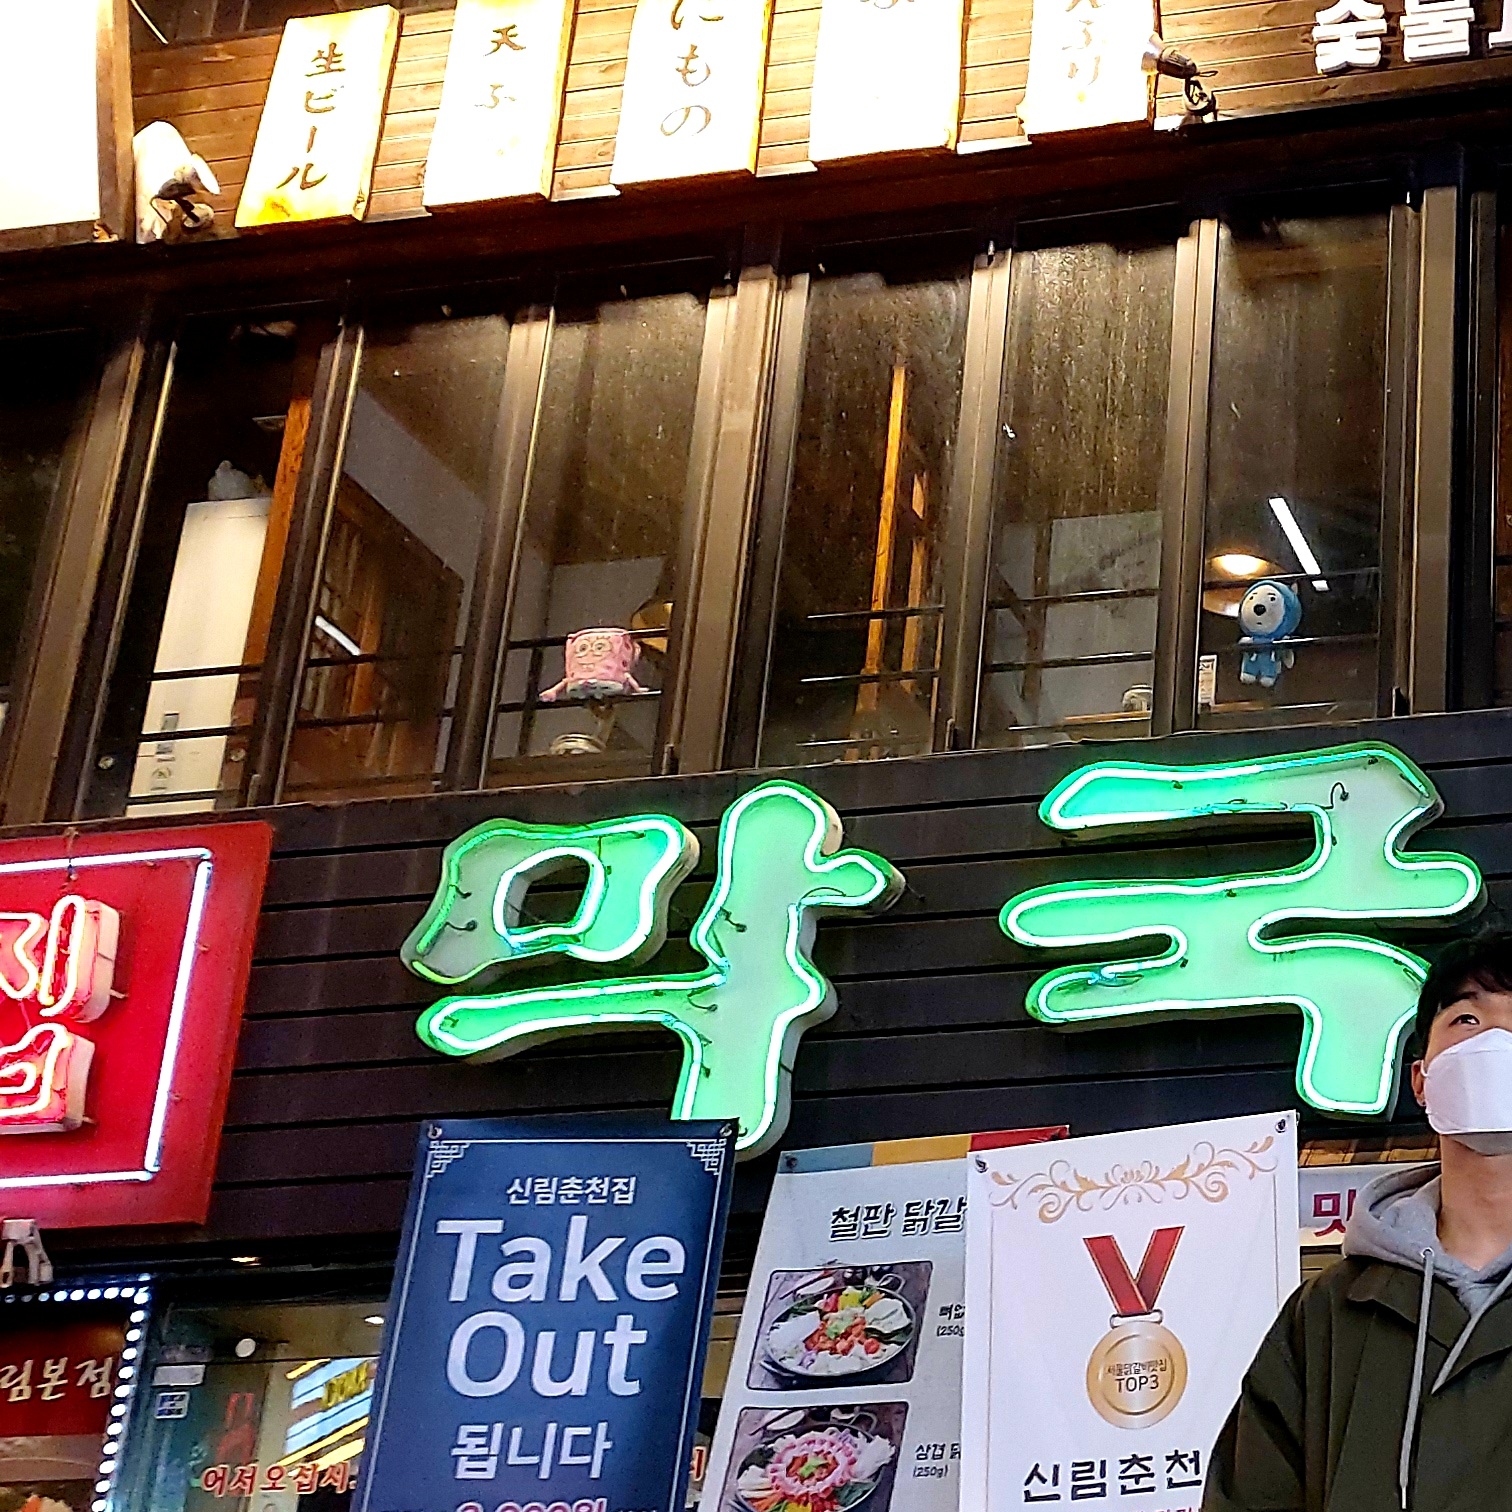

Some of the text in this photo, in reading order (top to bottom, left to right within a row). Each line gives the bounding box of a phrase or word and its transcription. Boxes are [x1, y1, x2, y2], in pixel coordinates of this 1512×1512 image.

[269, 42, 346, 190] 生ビール
[507, 1176, 637, 1206] 신림춘천집
[830, 1203, 897, 1243] 철판
[436, 1215, 687, 1303] Take
[446, 1310, 648, 1398] Out
[1115, 1374, 1161, 1394] TOP3
[451, 1421, 613, 1480] 됩니다
[914, 1443, 947, 1461] 삼겹
[201, 1460, 358, 1498] 어서오십시
[913, 1465, 949, 1479] (250g)
